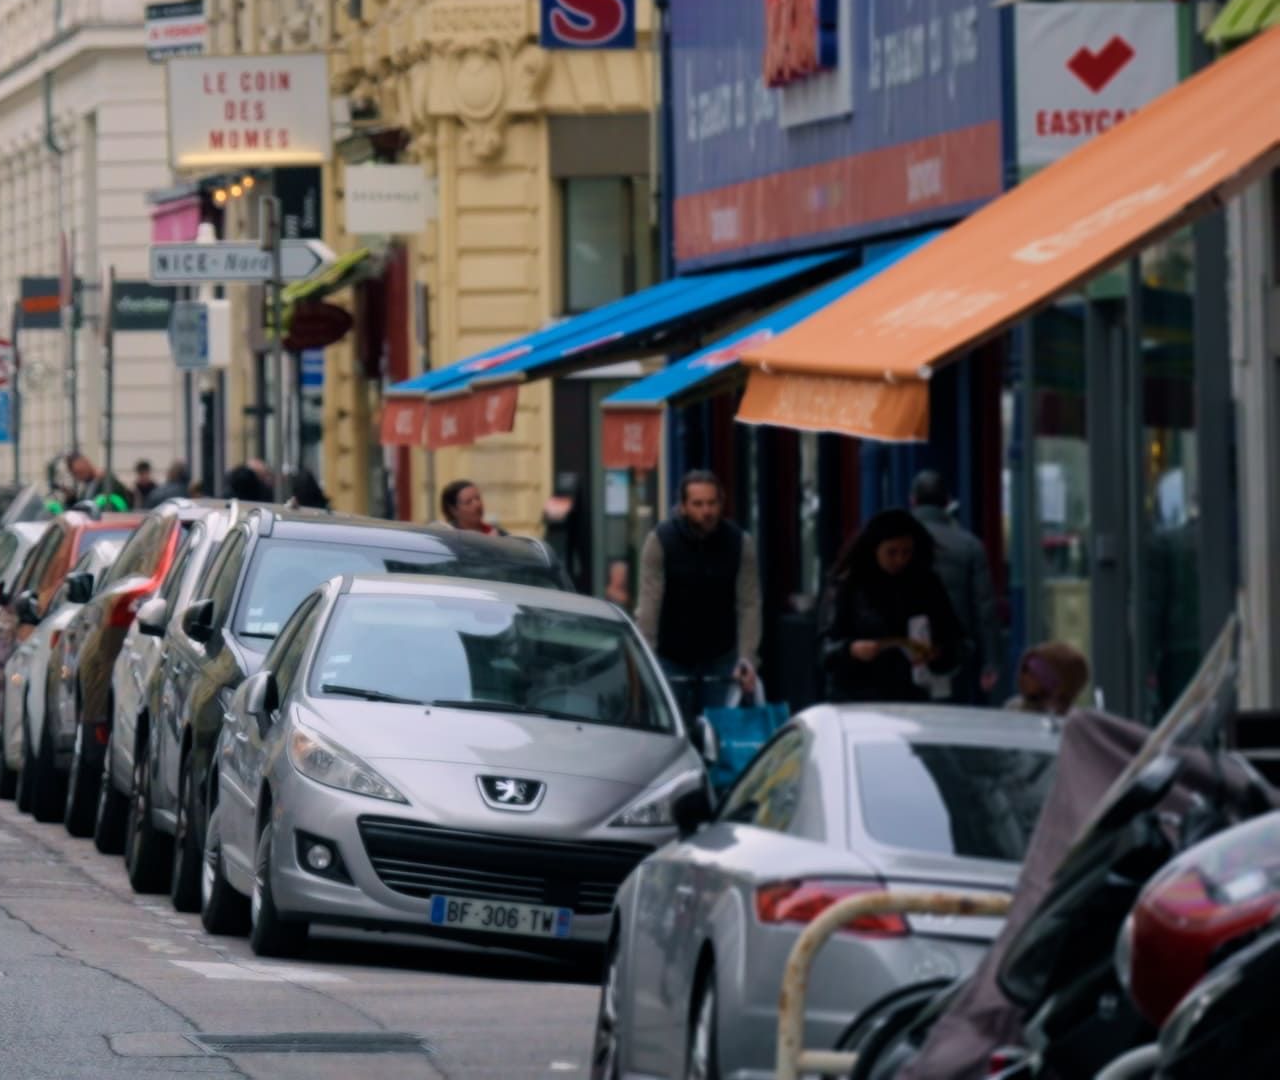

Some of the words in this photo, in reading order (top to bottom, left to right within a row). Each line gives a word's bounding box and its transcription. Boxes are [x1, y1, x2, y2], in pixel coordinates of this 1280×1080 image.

[203, 72, 227, 94] LE
[239, 71, 291, 93] COIN
[224, 100, 266, 121] DES
